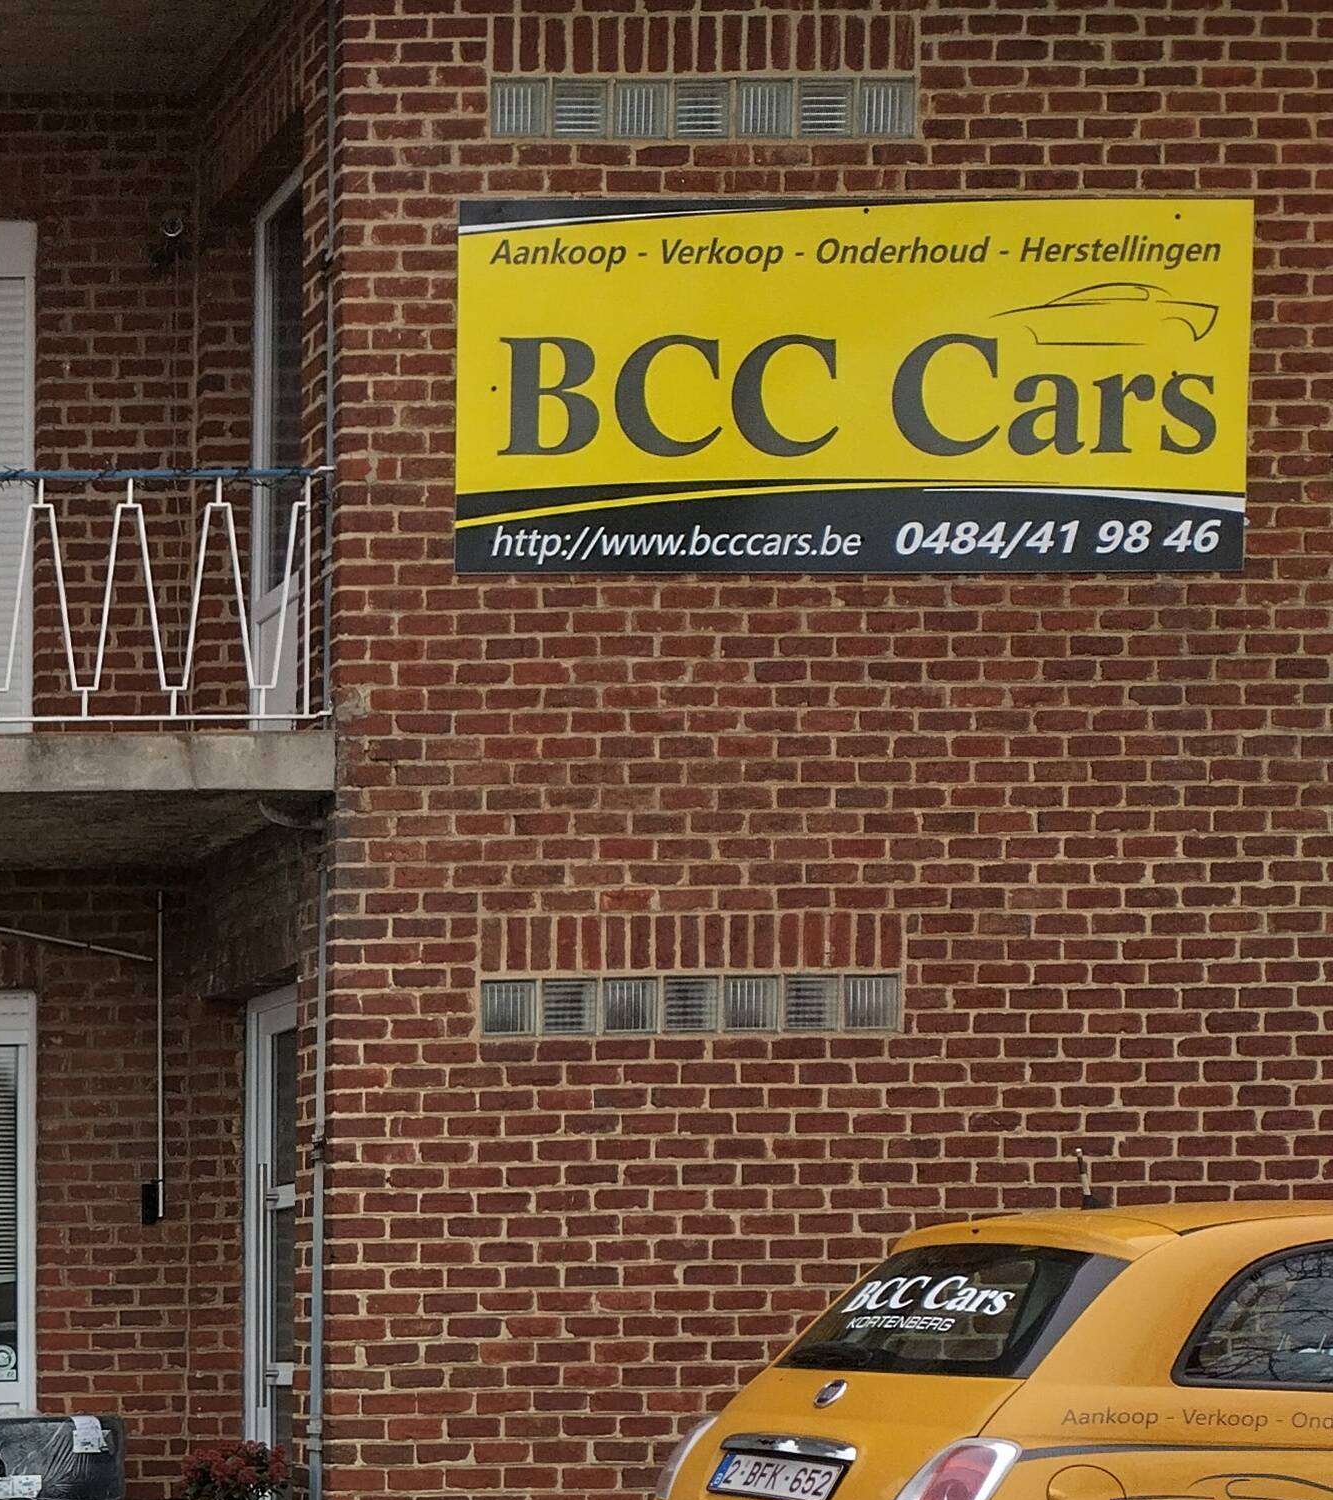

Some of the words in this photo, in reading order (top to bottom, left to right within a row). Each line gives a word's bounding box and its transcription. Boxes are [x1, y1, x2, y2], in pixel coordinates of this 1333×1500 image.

[490, 237, 626, 268] Aankoop
[661, 237, 784, 268] Verkoop
[815, 236, 987, 265] Onderhoud
[1019, 236, 1221, 269] Herstellingen
[497, 333, 839, 457] BCC
[891, 333, 1218, 457] Cars
[490, 525, 862, 562] http://www.bcccars.be
[894, 520, 1078, 560] 0484/41
[1095, 520, 1153, 555] 98
[1163, 519, 1221, 553] 46
[841, 1275, 933, 1314] BCC
[923, 1275, 1016, 1316] Cars
[846, 1315, 956, 1332] KORTENBERG
[1061, 1407, 1159, 1429] Aankoop
[1182, 1408, 1269, 1431] Verkoop
